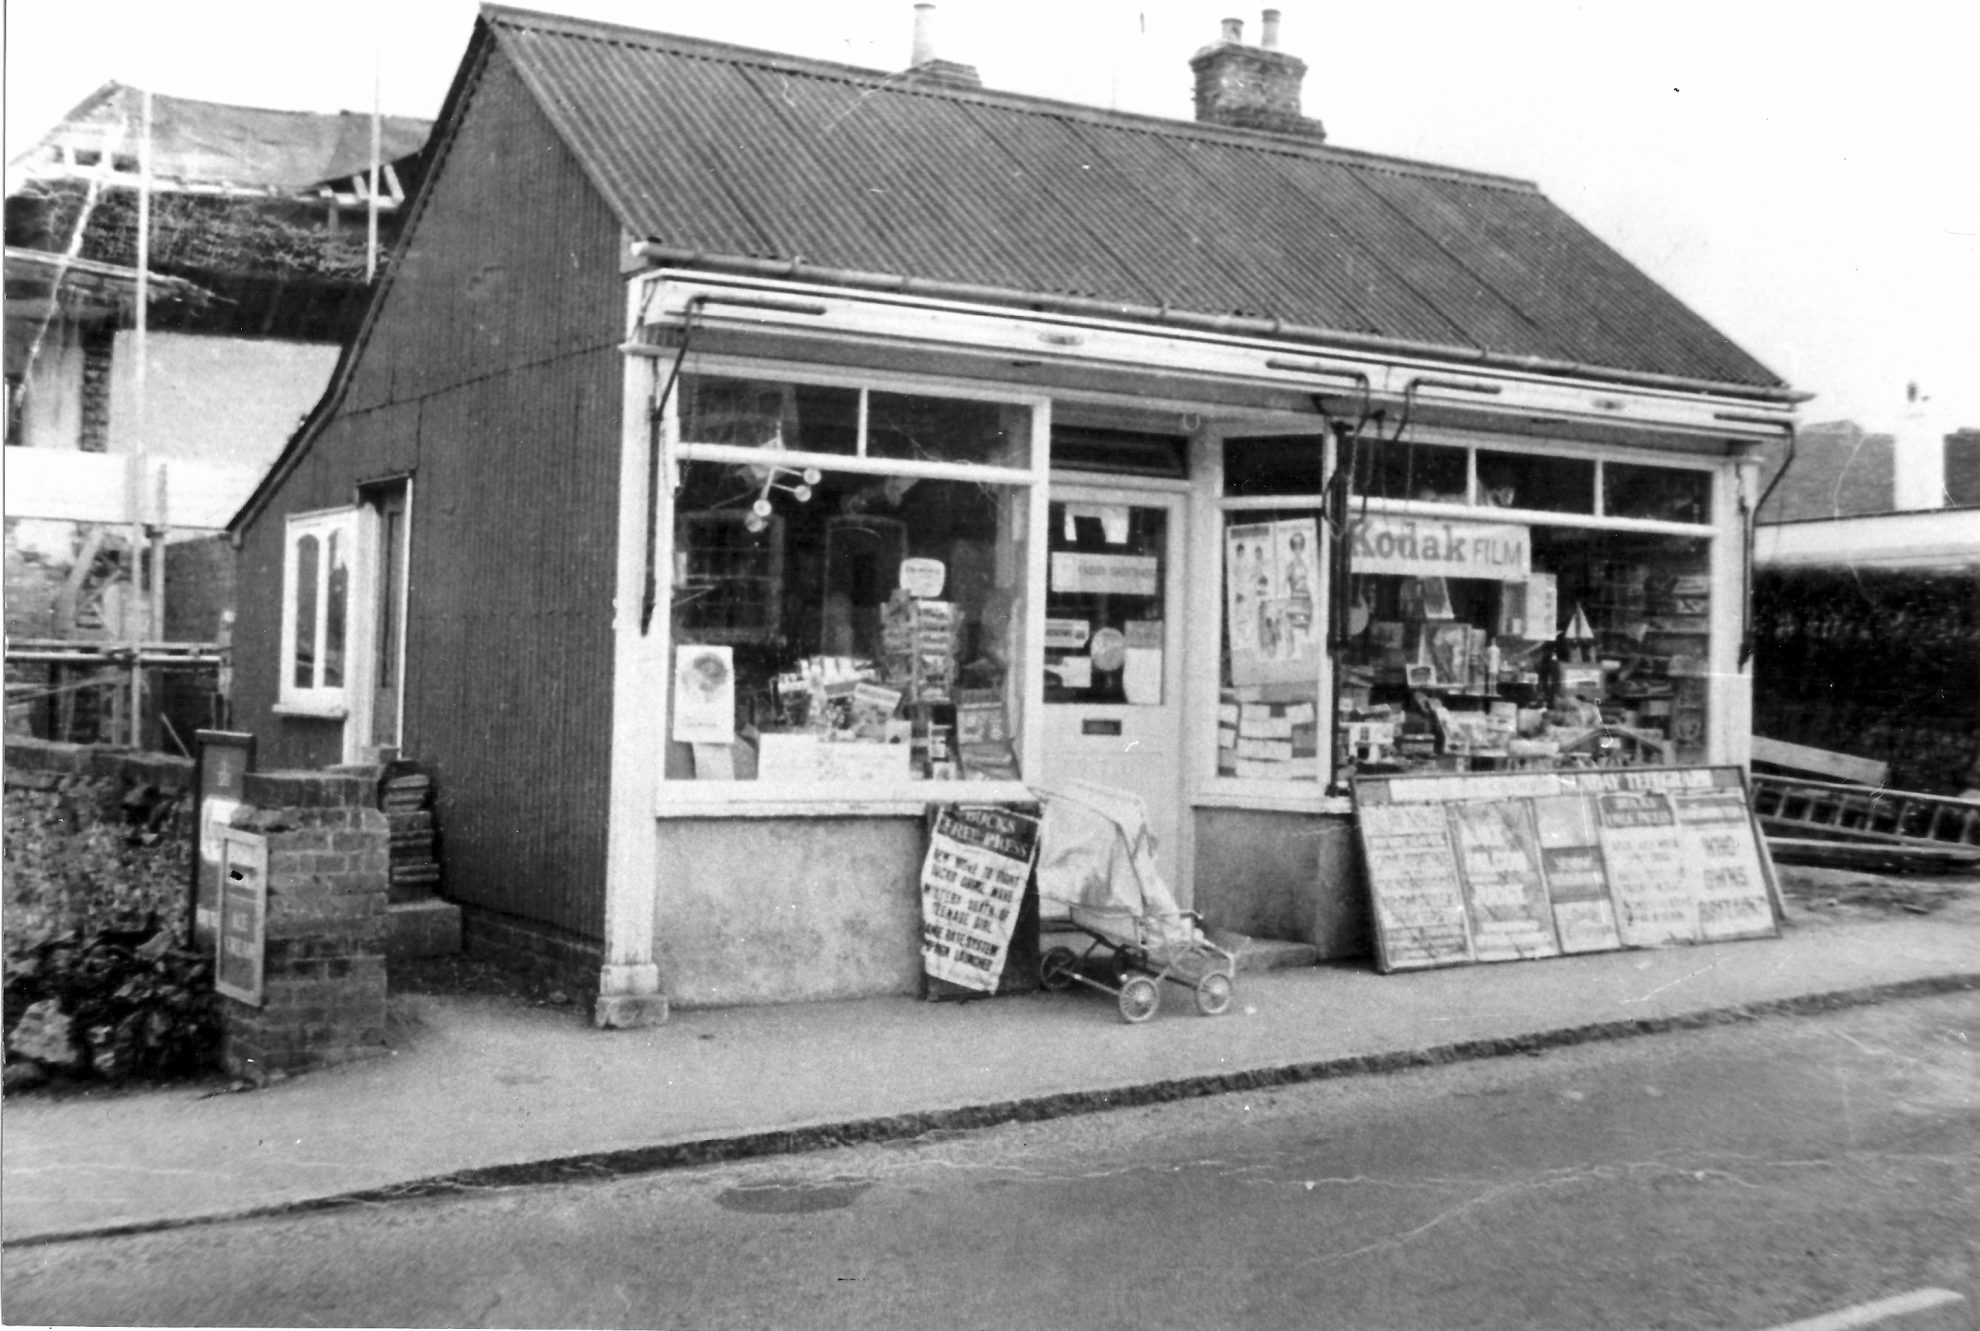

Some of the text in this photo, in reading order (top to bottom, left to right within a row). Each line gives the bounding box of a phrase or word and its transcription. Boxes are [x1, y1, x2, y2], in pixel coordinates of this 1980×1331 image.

[1351, 517, 1522, 566] Kodak FILM
[965, 810, 1016, 833] BUCKS
[941, 819, 1027, 858] FREE PRESS
[984, 866, 994, 878] TO
[933, 902, 991, 933] TEENAGE GIRL
[968, 899, 995, 914] DEATH
[998, 908, 1010, 921] OF
